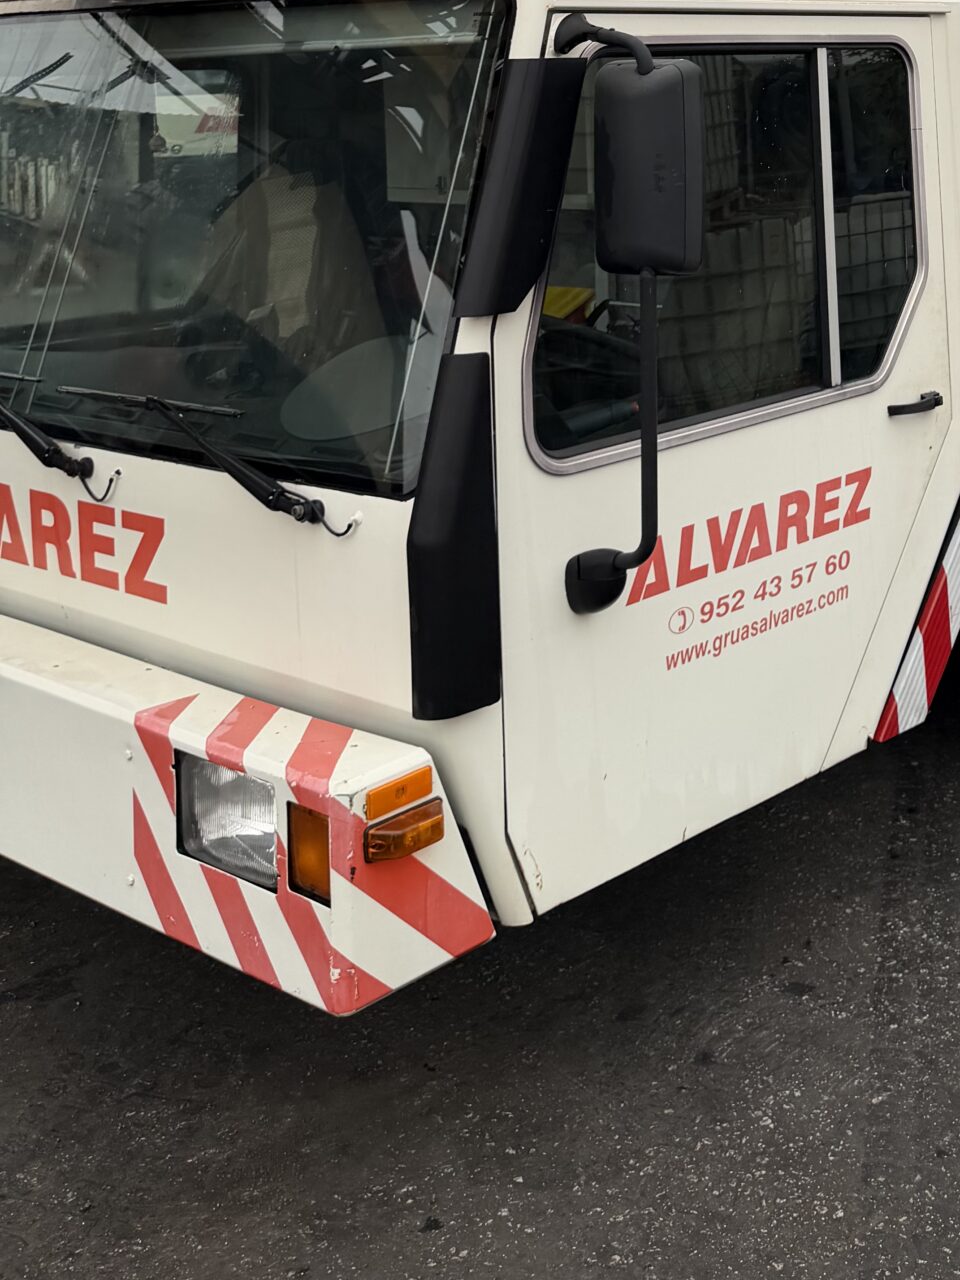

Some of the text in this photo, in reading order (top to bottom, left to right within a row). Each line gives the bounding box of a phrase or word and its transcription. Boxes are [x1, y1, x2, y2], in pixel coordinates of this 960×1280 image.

[625, 466, 872, 607] ALVAREZ
[665, 584, 849, 671] www.gruasalvarez.com
[699, 549, 851, 625] 952 43 57 60
